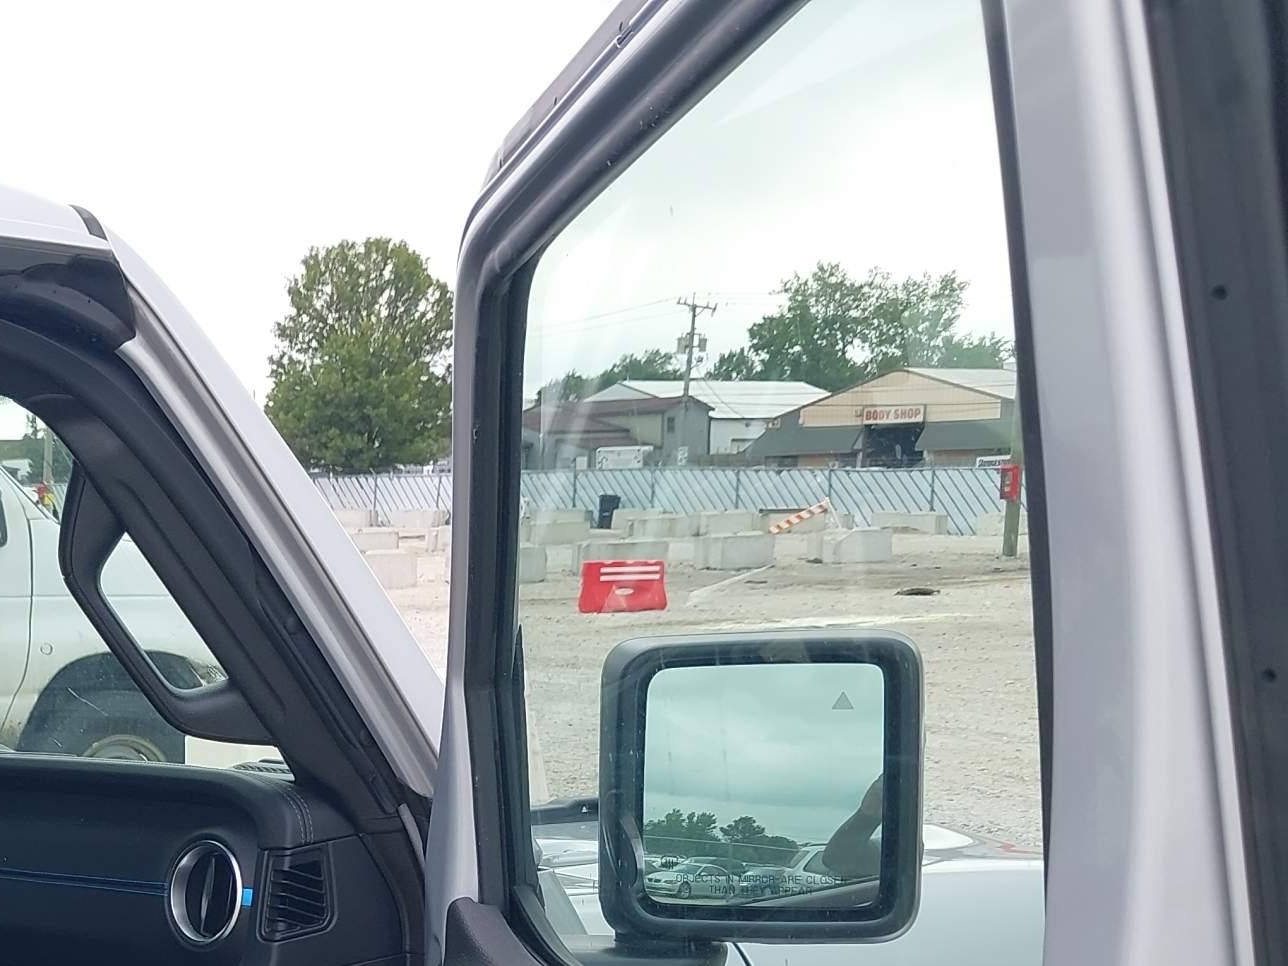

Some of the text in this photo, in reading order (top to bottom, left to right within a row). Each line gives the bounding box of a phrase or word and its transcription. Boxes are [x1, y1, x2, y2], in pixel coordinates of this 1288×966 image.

[865, 408, 920, 420] BODY SHOP
[676, 874, 721, 883] OBJECTS
[725, 874, 734, 884] IN
[739, 874, 775, 884] MIRROR
[782, 875, 802, 885] ARE
[708, 885, 735, 894] THAN
